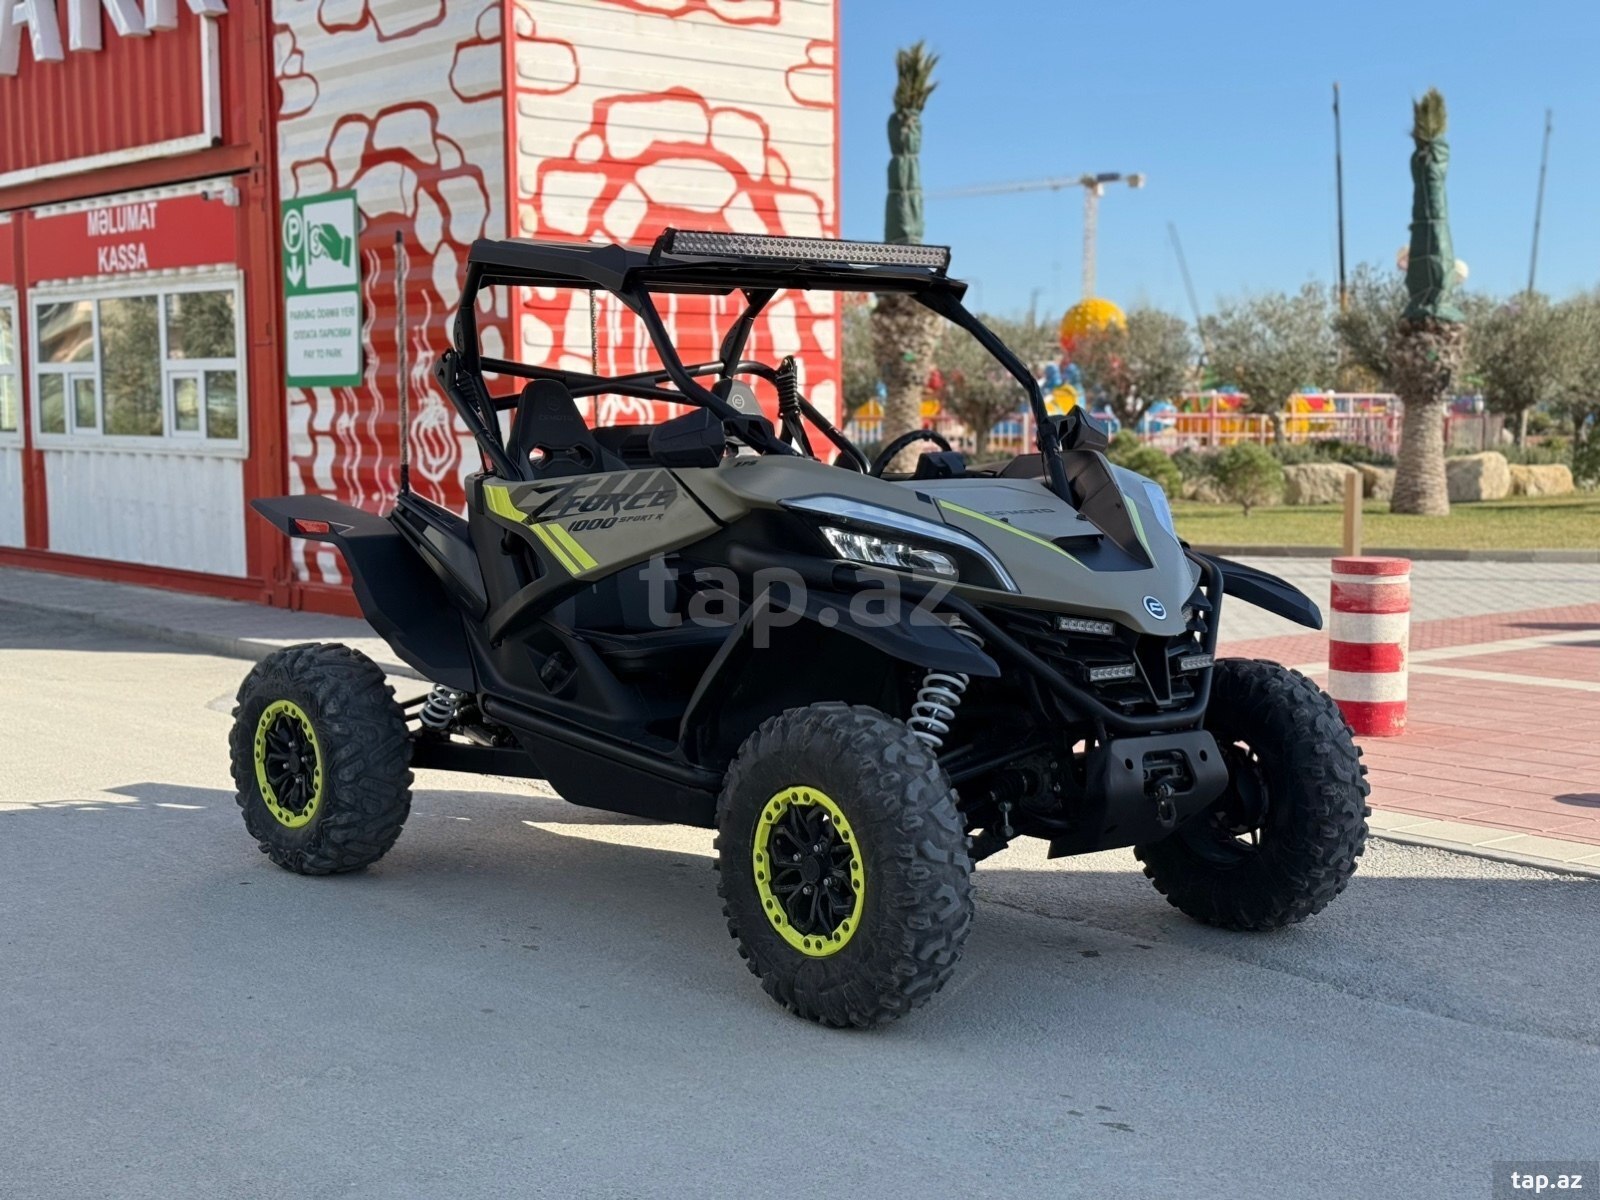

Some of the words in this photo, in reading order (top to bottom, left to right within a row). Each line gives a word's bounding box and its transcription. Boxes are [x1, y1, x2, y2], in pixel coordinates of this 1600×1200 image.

[87, 202, 158, 237] MƏLUMAT
[98, 243, 148, 272] KASSA
[567, 516, 618, 532] 1000
[619, 514, 653, 523] SPORT
[654, 513, 664, 521] R
